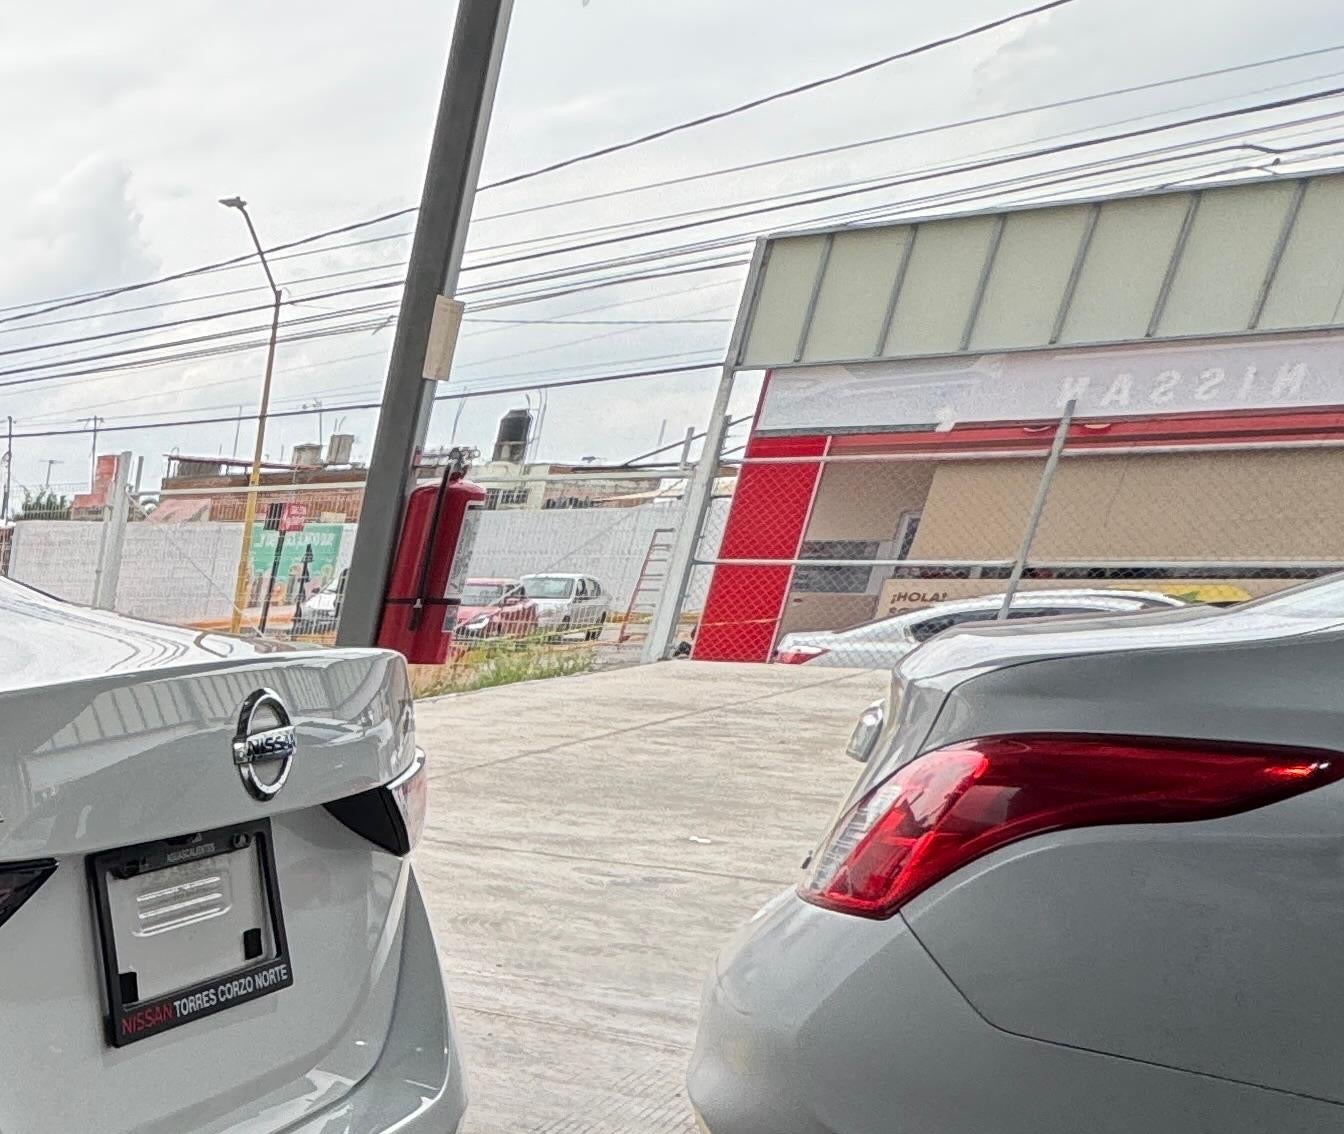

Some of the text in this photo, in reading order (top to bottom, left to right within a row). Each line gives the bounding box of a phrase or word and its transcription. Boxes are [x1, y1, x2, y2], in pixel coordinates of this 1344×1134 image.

[246, 732, 296, 757] NISSAN
[122, 964, 288, 1035] NISSAN TORRES CORZO NORTE
